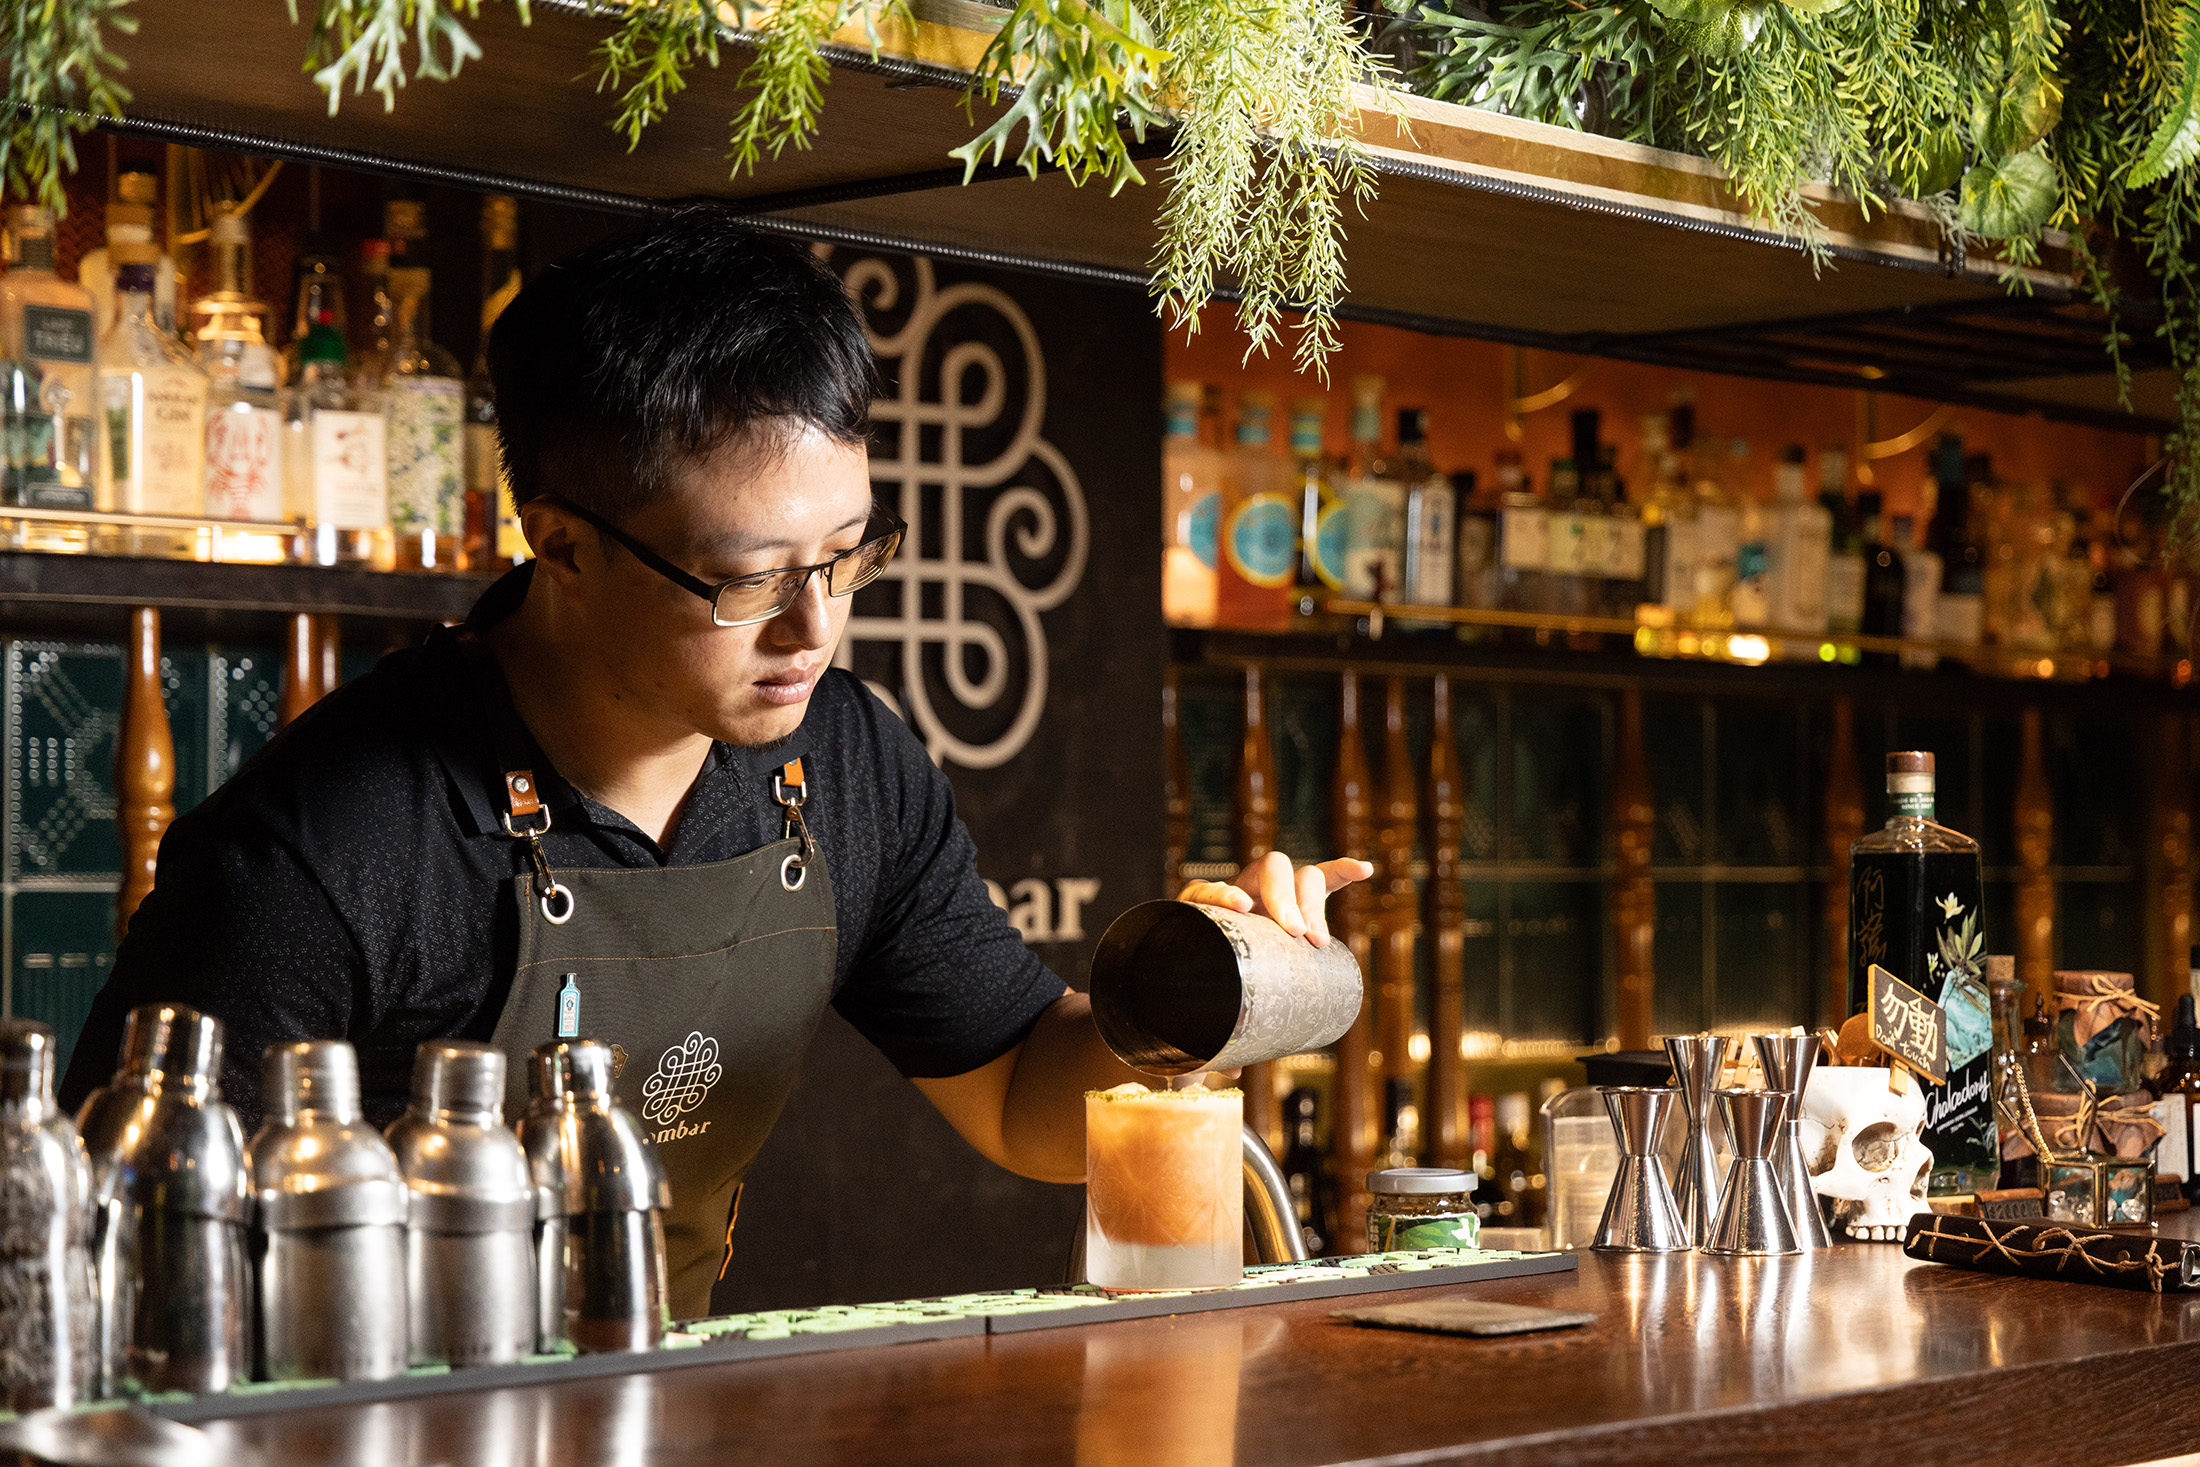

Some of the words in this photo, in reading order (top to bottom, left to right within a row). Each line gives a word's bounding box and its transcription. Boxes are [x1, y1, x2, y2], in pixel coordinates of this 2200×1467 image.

[1880, 982, 1938, 1062] 勿動
[1899, 1040, 1932, 1072] touch
[1925, 1067, 1990, 1130] Chalcedony
